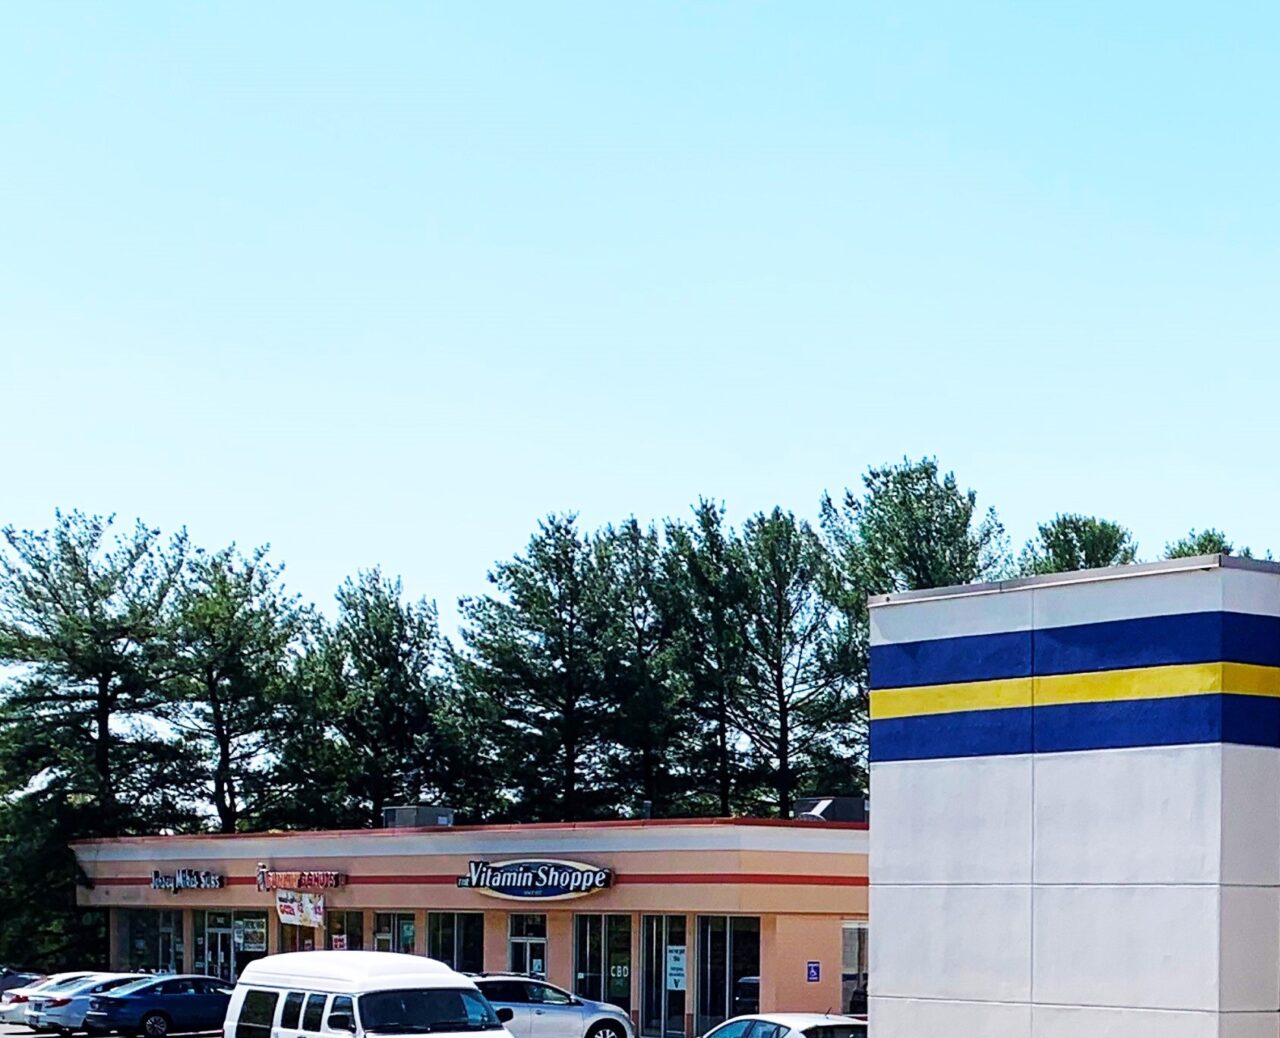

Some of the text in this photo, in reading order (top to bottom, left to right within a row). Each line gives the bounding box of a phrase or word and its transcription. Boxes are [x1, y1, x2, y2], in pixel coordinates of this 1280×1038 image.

[469, 862, 533, 887] Vitamin
[535, 865, 607, 891] Shoppe
[610, 965, 629, 978] CBD
